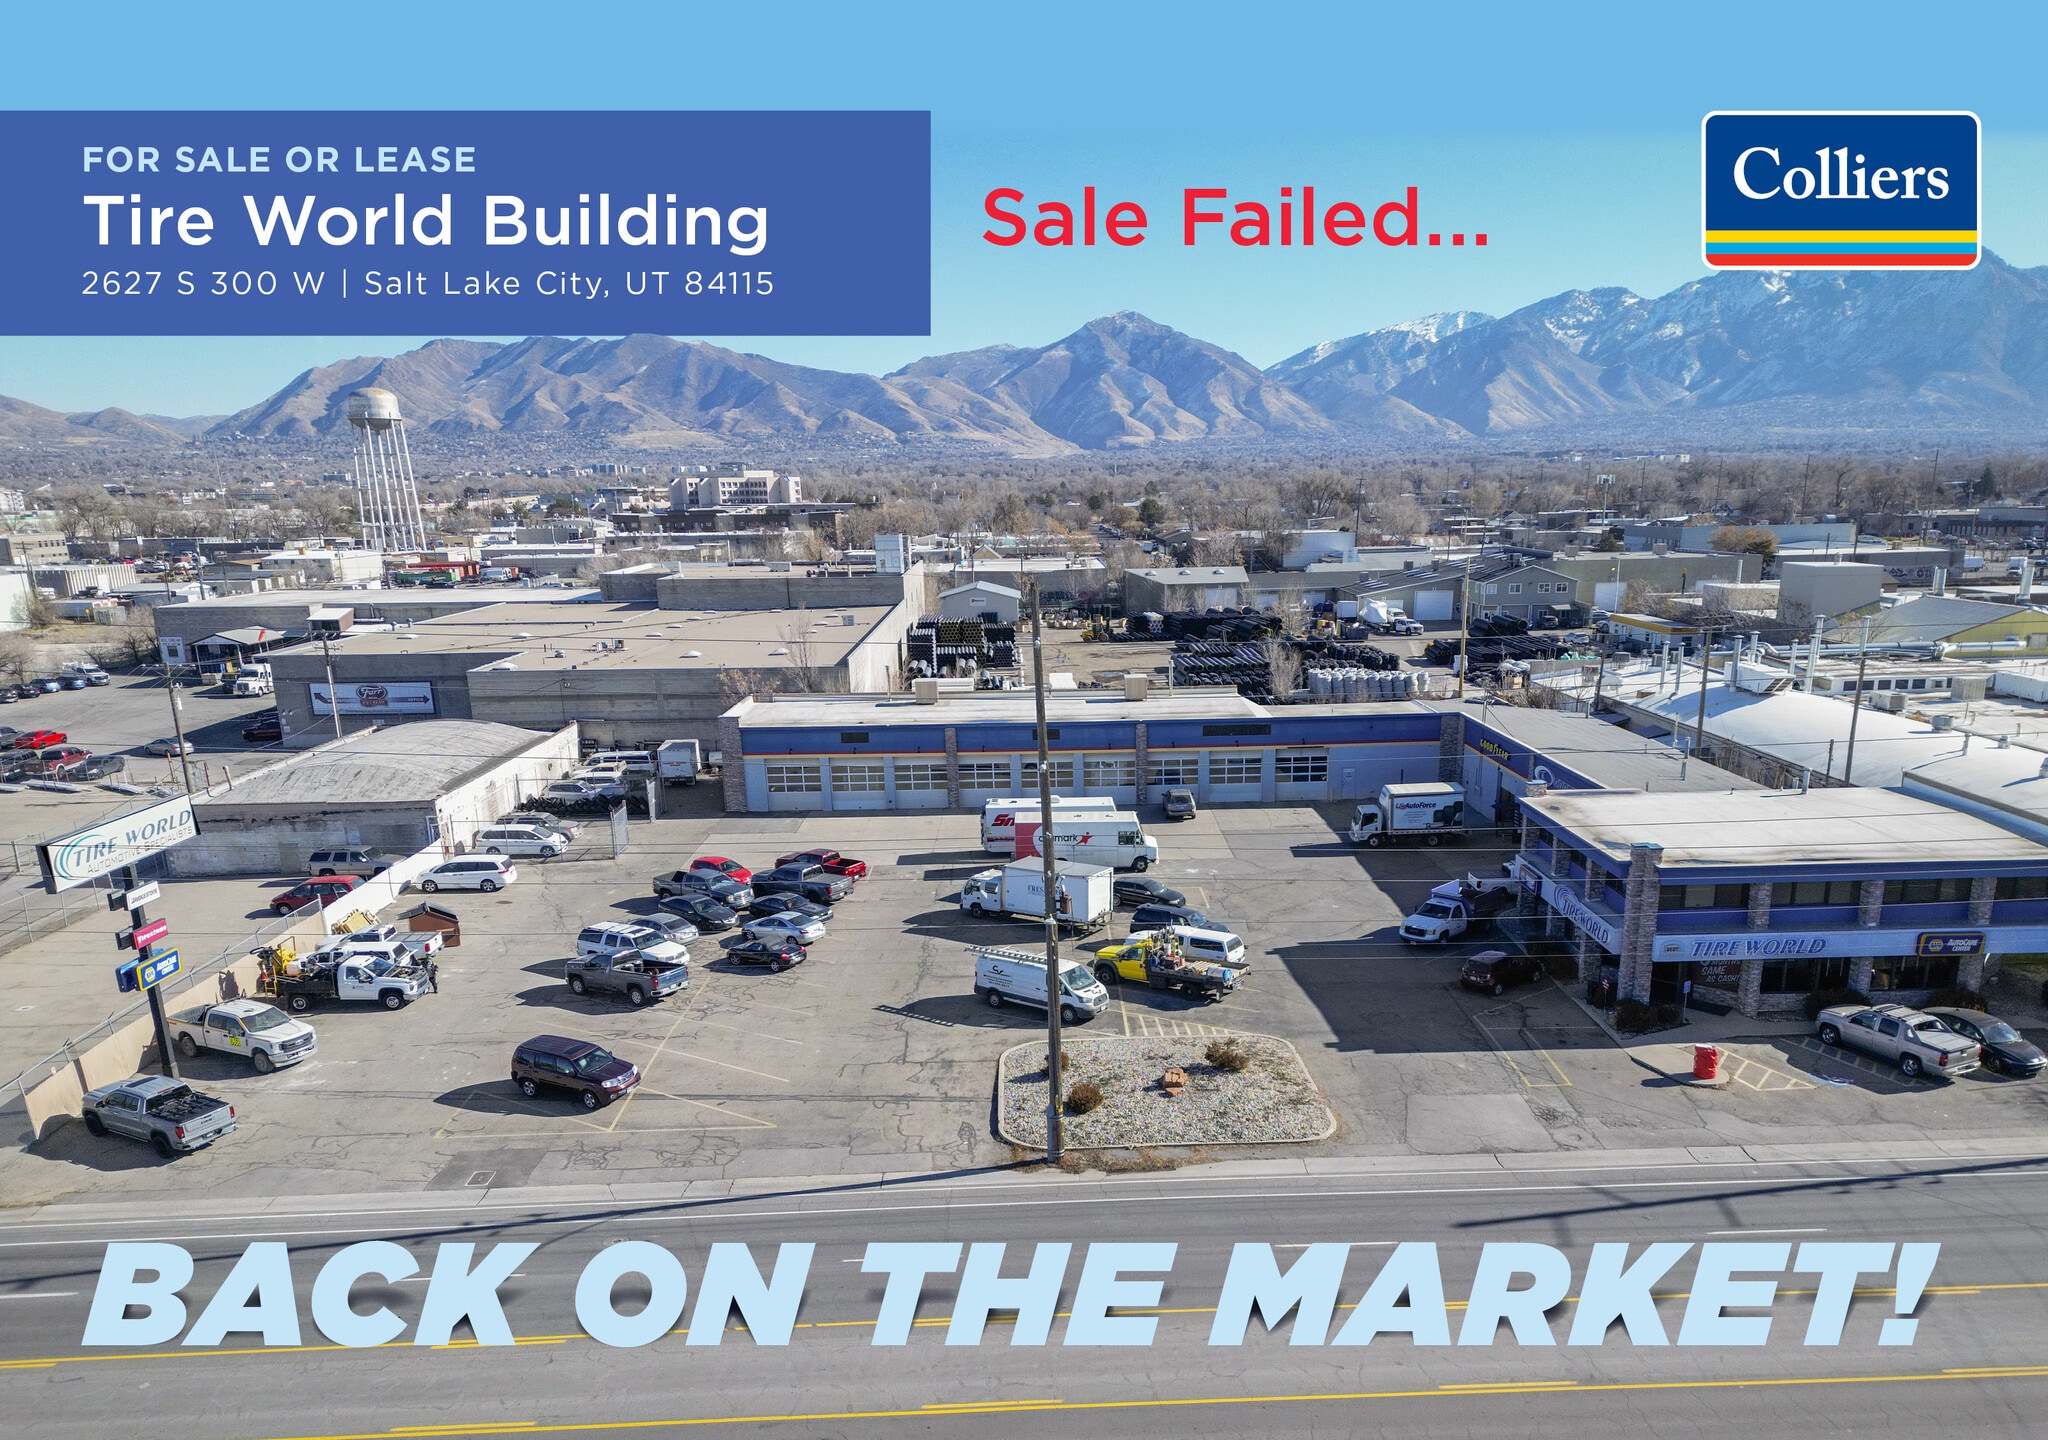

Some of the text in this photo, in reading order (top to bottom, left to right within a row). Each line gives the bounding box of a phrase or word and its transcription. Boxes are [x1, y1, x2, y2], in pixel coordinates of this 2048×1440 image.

[361, 686, 382, 699] Farr
[74, 809, 191, 868] TIRE WORLD
[87, 826, 193, 875] AUTOMOTIVE SPECIALISTS
[1562, 899, 1609, 944] TIRE WORLD
[137, 925, 167, 943] Firestone
[1691, 940, 1742, 958] TIRE
[1744, 938, 1828, 956] WORLD
[1701, 966, 1727, 976] SAME
